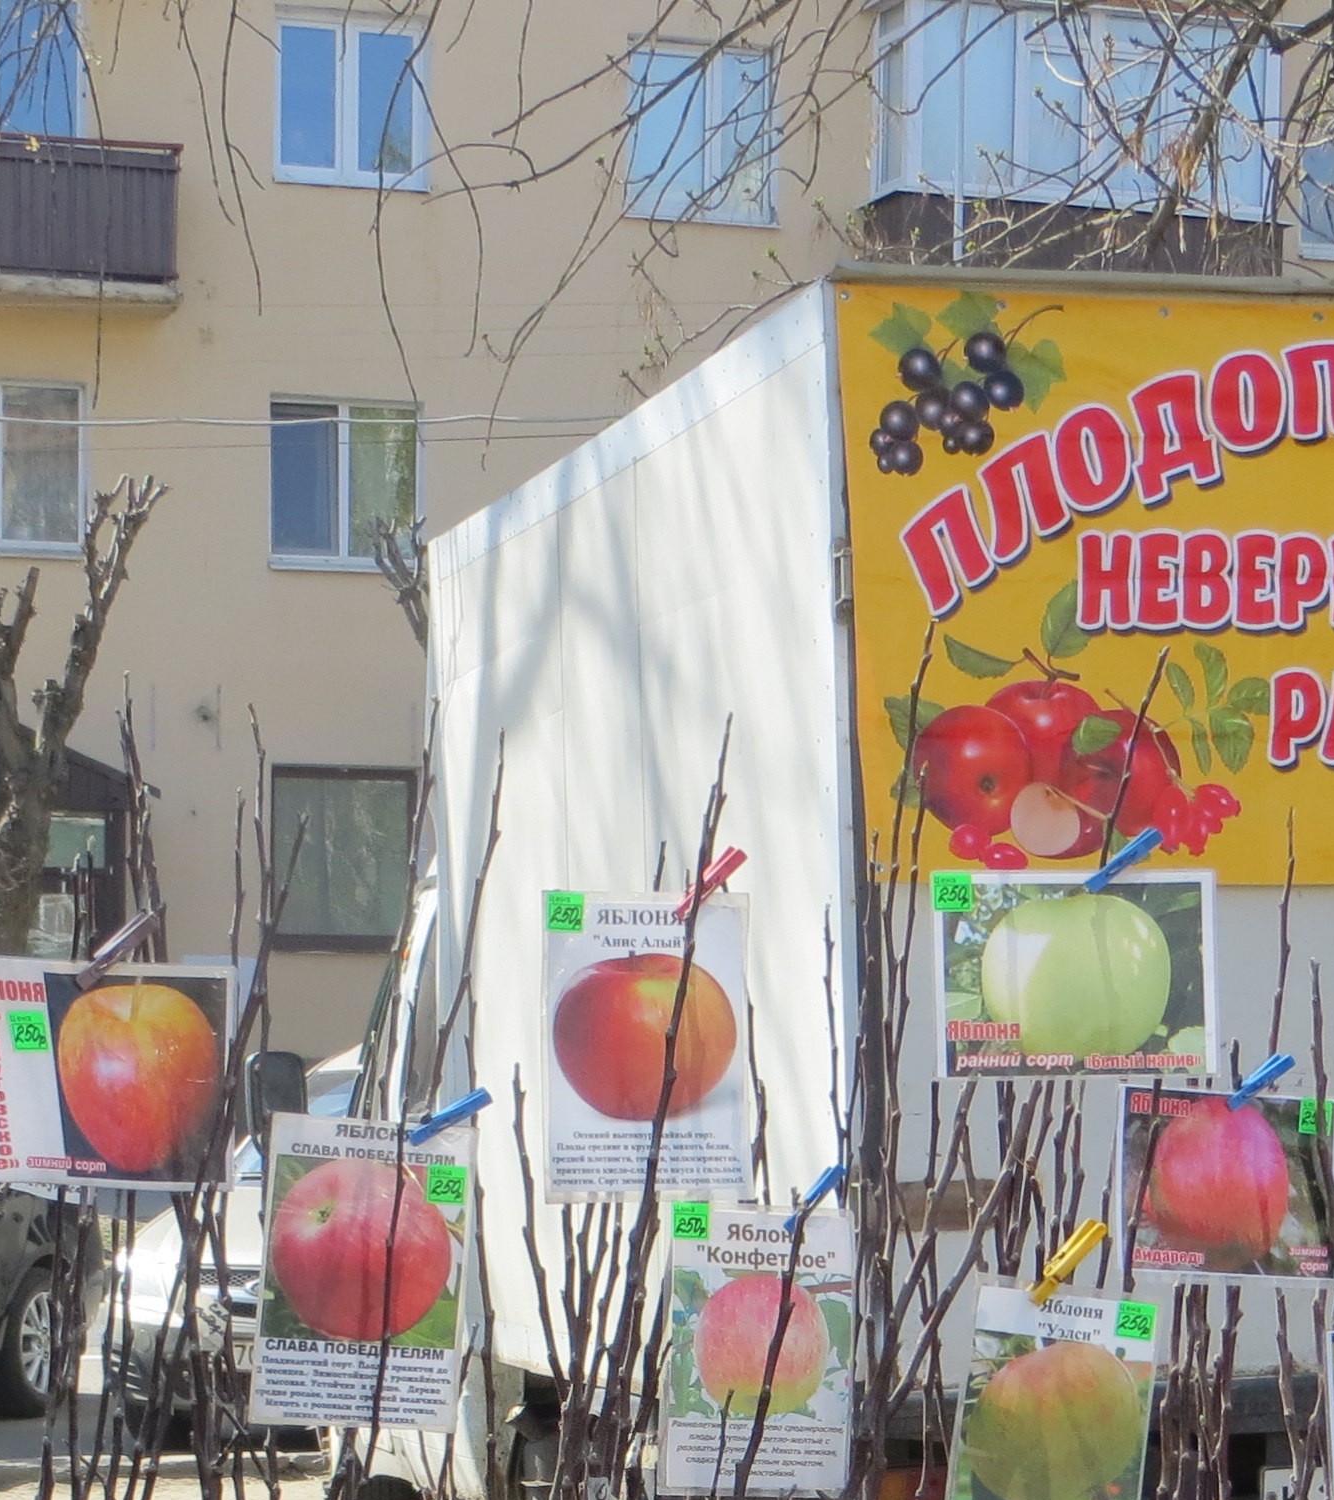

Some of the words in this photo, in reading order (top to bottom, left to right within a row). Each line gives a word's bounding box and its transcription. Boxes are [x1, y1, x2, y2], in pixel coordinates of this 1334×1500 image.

[593, 935, 637, 948] "Анис
[947, 1020, 1021, 1041] Яблоня
[955, 1051, 1021, 1071] ранний
[1026, 1054, 1074, 1071] сорт
[1130, 1092, 1191, 1117] Ябоня
[26, 1155, 74, 1170] зимний
[75, 1158, 107, 1174] сорт
[291, 1142, 341, 1158] СЛАВА
[345, 1146, 456, 1166] ПОБЕДТЕЛЯМ
[1040, 1298, 1104, 1320] Яблоня
[1037, 1321, 1101, 1342] "Уэлси"
[265, 1338, 319, 1354] СЛАВА
[323, 1342, 445, 1361] ПОБЕДТЕЛЯМ
